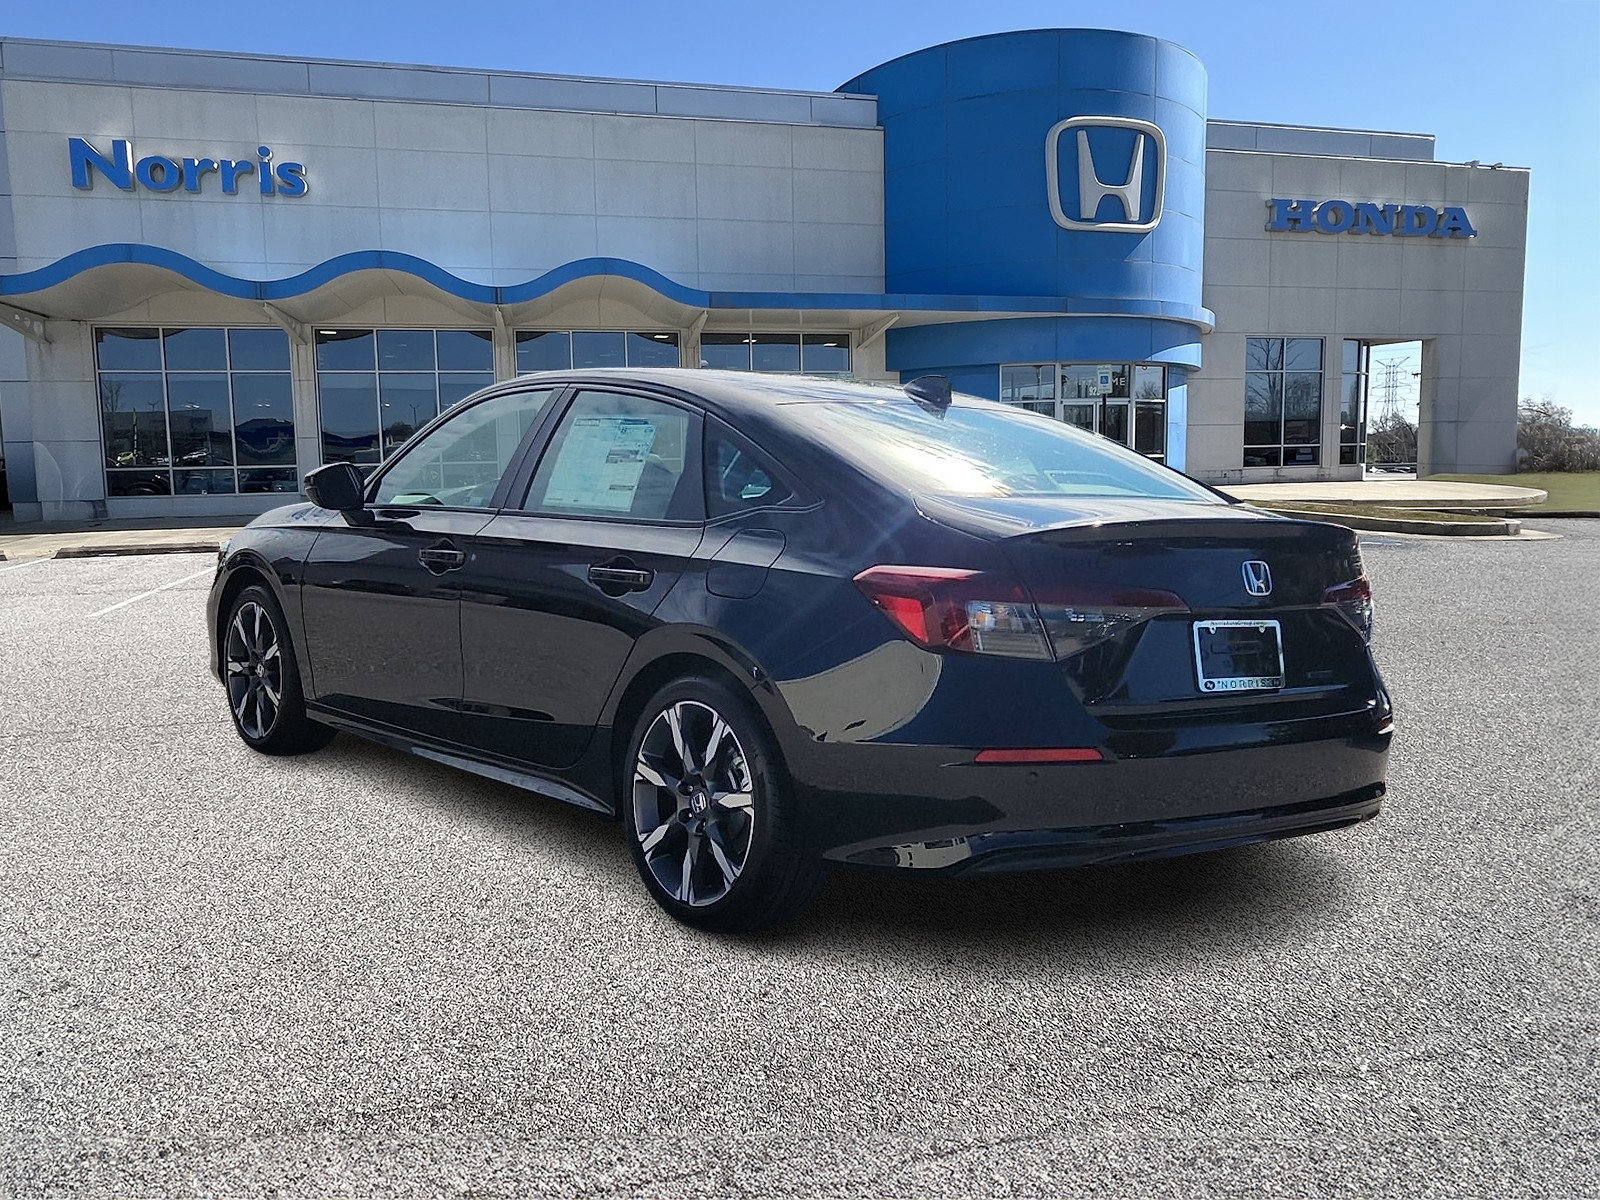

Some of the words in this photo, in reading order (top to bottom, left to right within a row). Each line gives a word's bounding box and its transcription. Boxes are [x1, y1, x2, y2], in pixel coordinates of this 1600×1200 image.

[68, 137, 309, 197] Norris
[1265, 198, 1478, 239] HONDA
[1221, 679, 1267, 689] NORRIS
